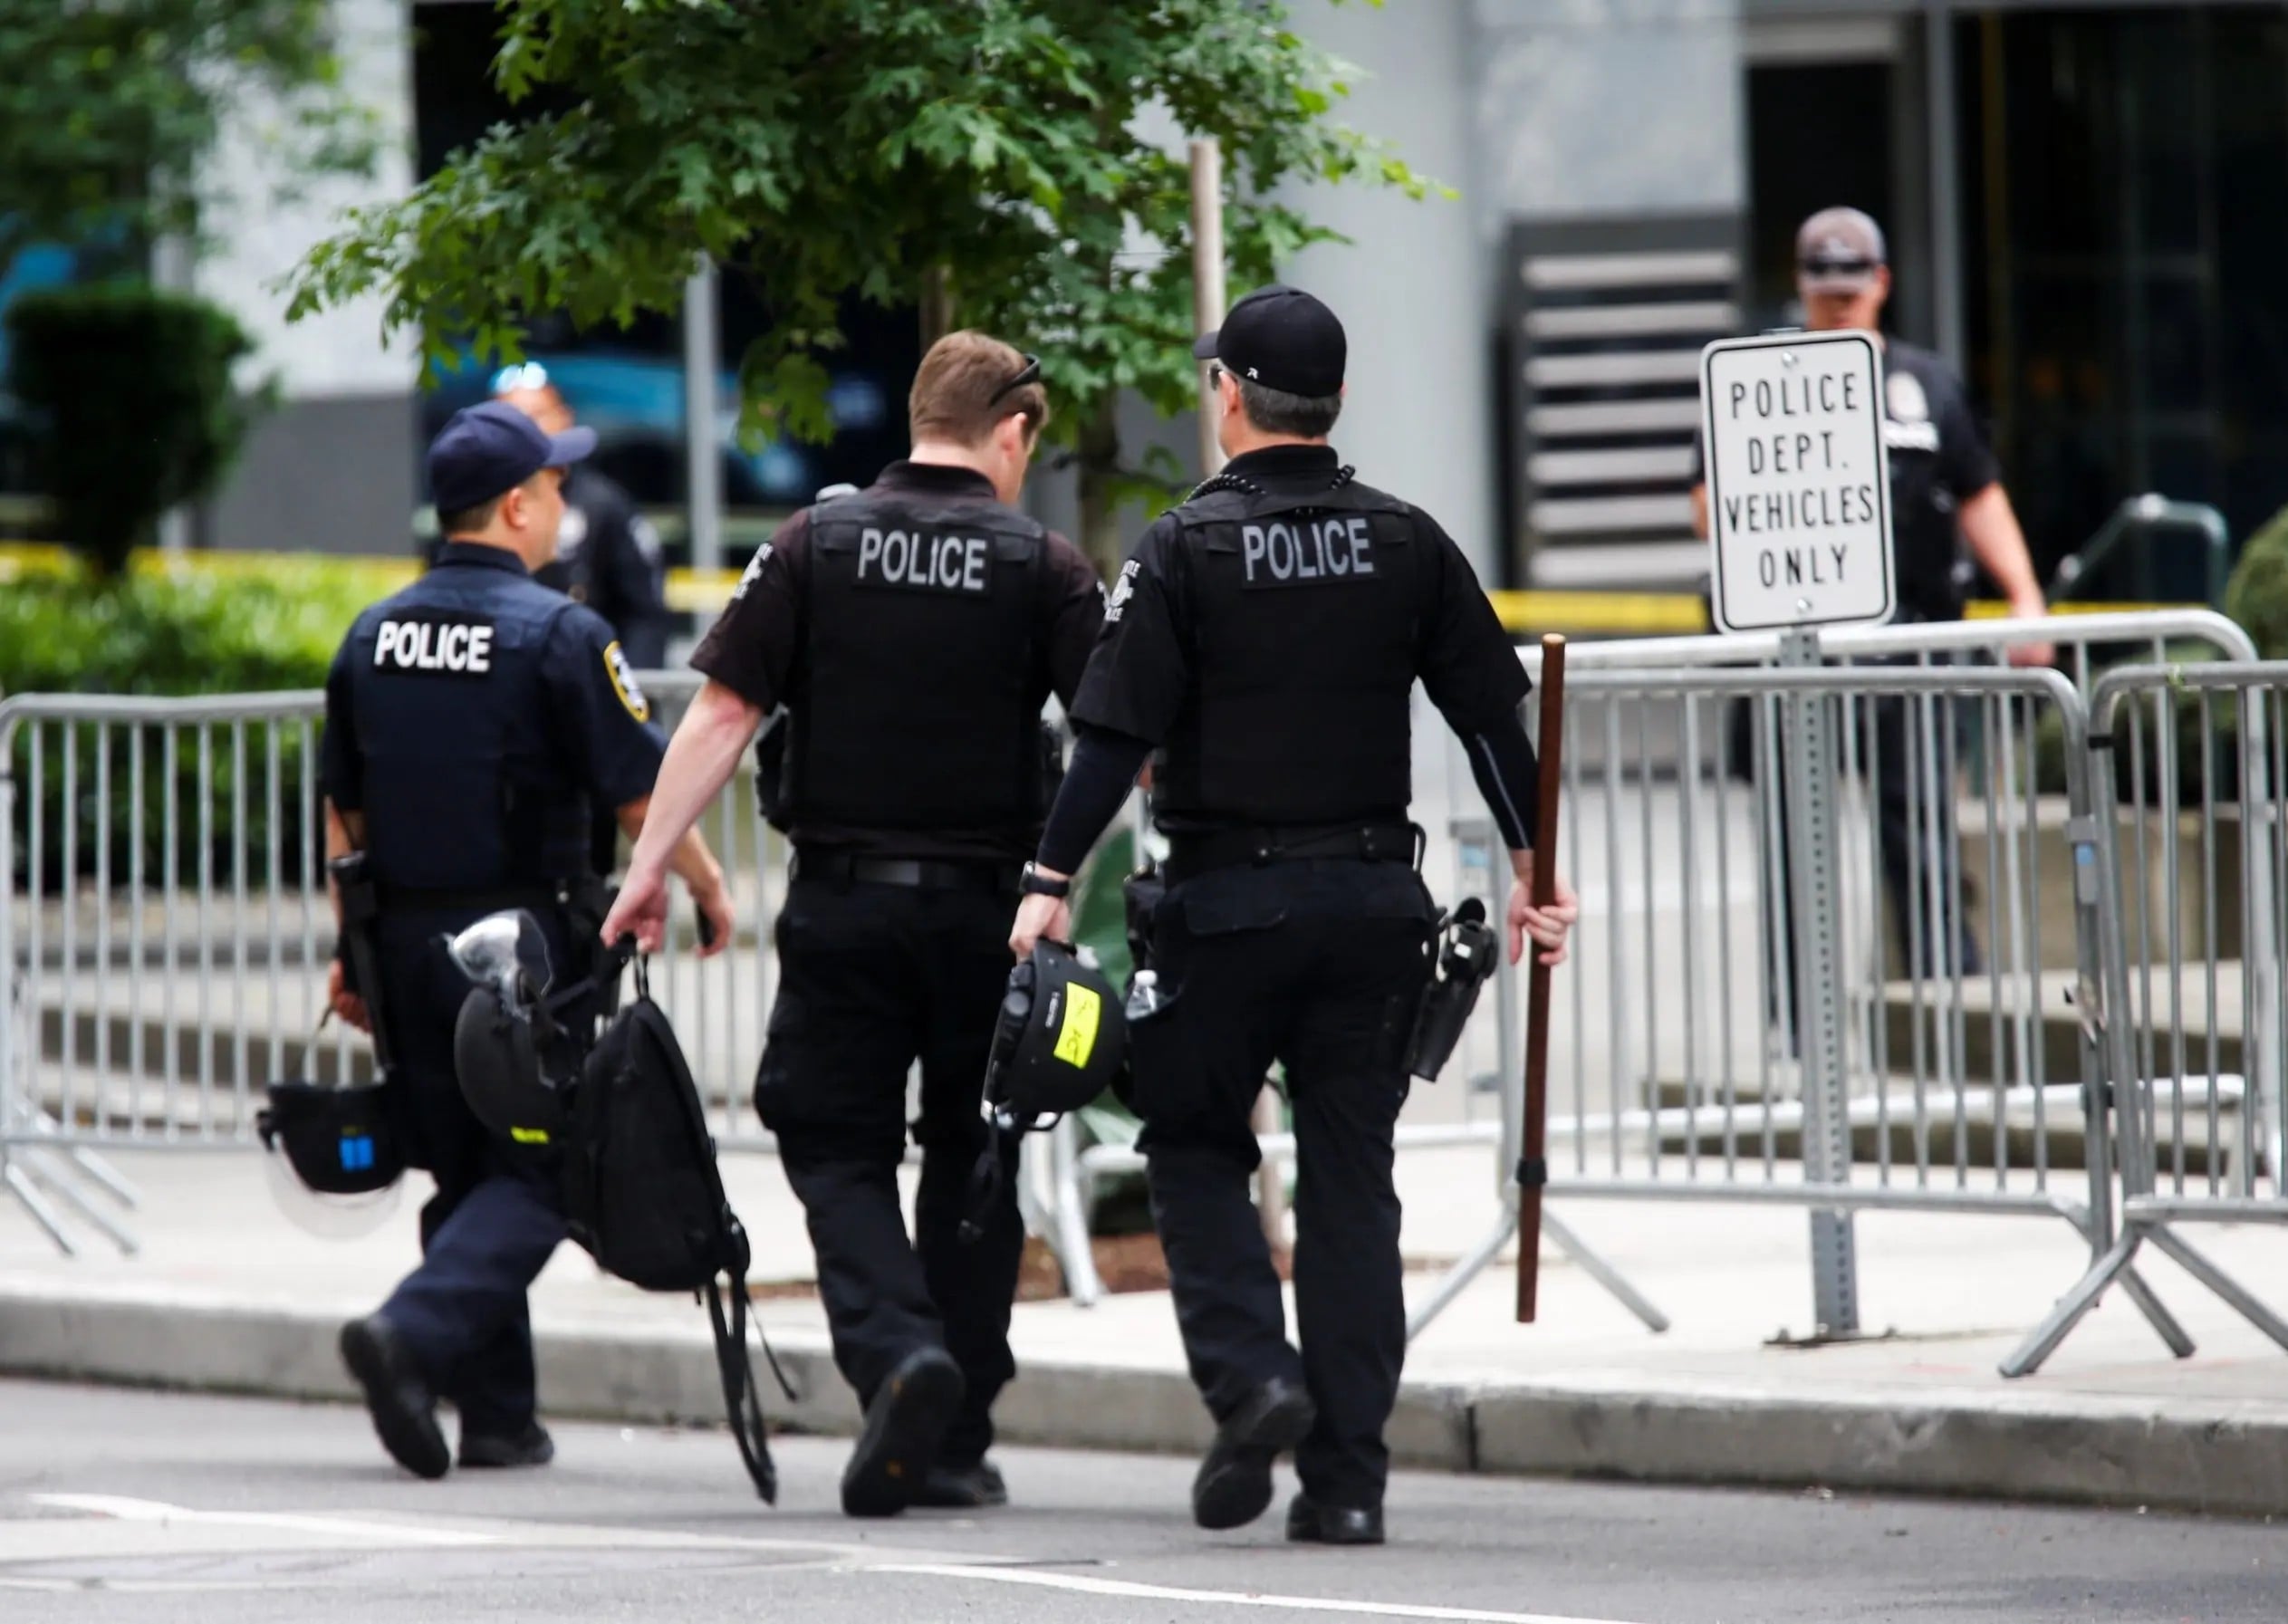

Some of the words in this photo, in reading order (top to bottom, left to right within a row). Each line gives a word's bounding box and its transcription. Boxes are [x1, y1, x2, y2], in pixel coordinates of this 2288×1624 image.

[1730, 372, 1858, 419] POLICE
[1748, 430, 1849, 475] DEPT.
[1725, 485, 1874, 533] VEHICLES
[857, 527, 987, 591] POLICE
[1242, 518, 1374, 581] POLICE
[1758, 543, 1849, 589] ONLY
[373, 620, 494, 672] POLICE
